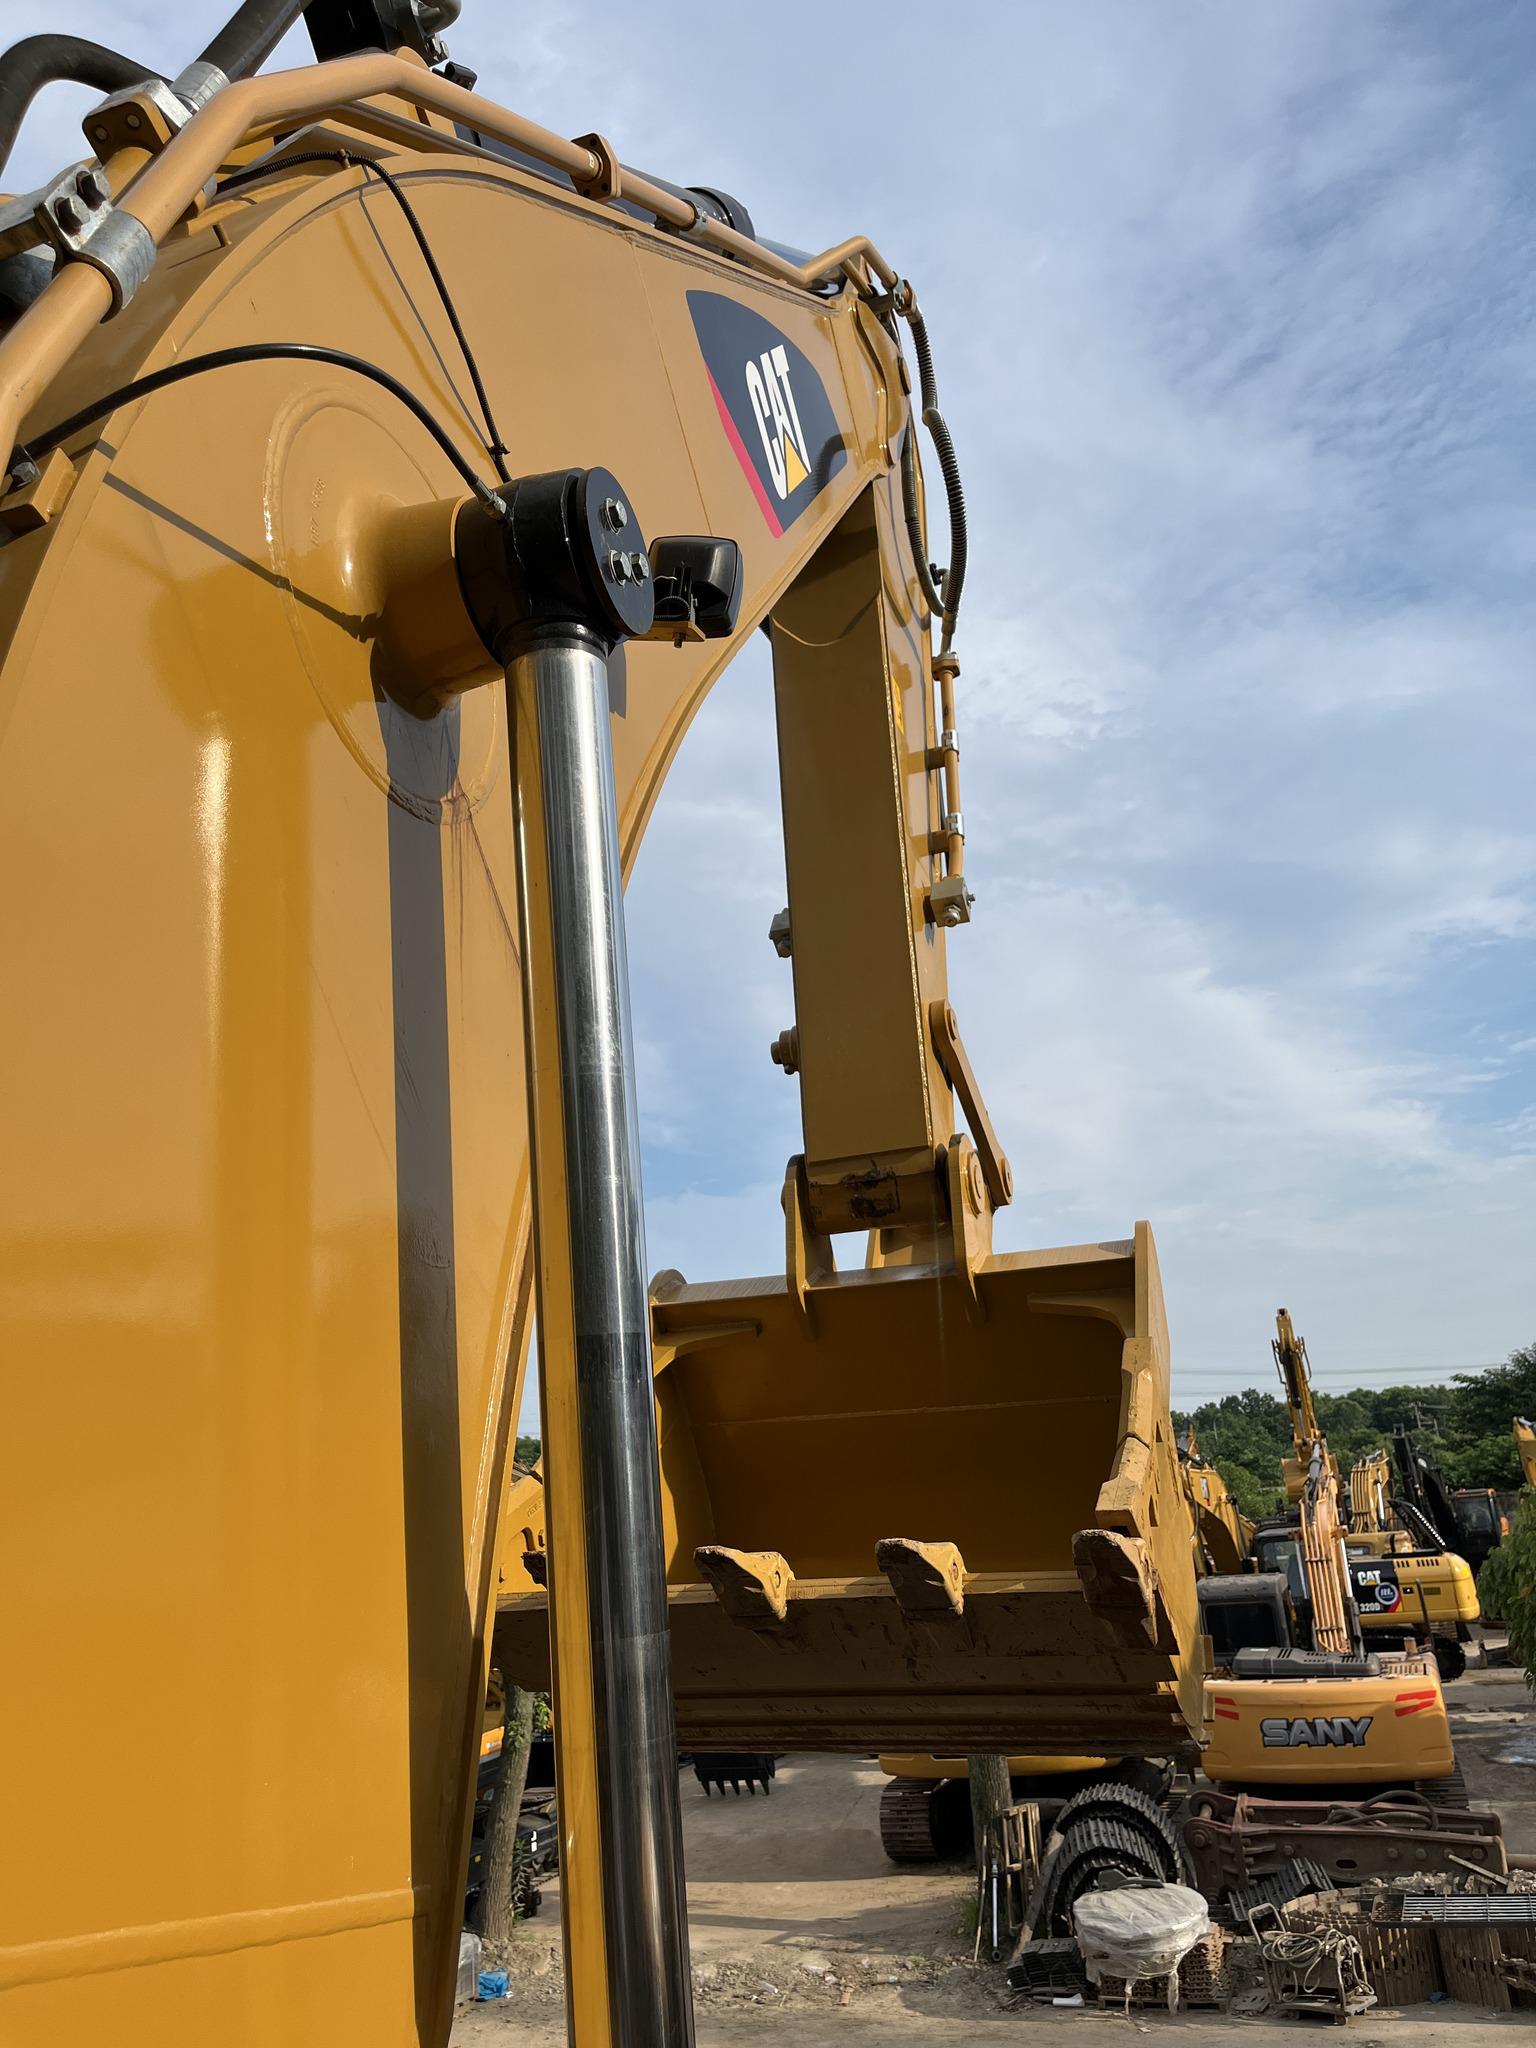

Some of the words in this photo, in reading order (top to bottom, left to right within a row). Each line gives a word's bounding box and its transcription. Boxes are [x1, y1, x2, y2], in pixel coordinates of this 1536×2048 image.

[746, 345, 812, 500] CAT
[1357, 1570, 1381, 1586] CAT
[1261, 1717, 1373, 1747] SANY
